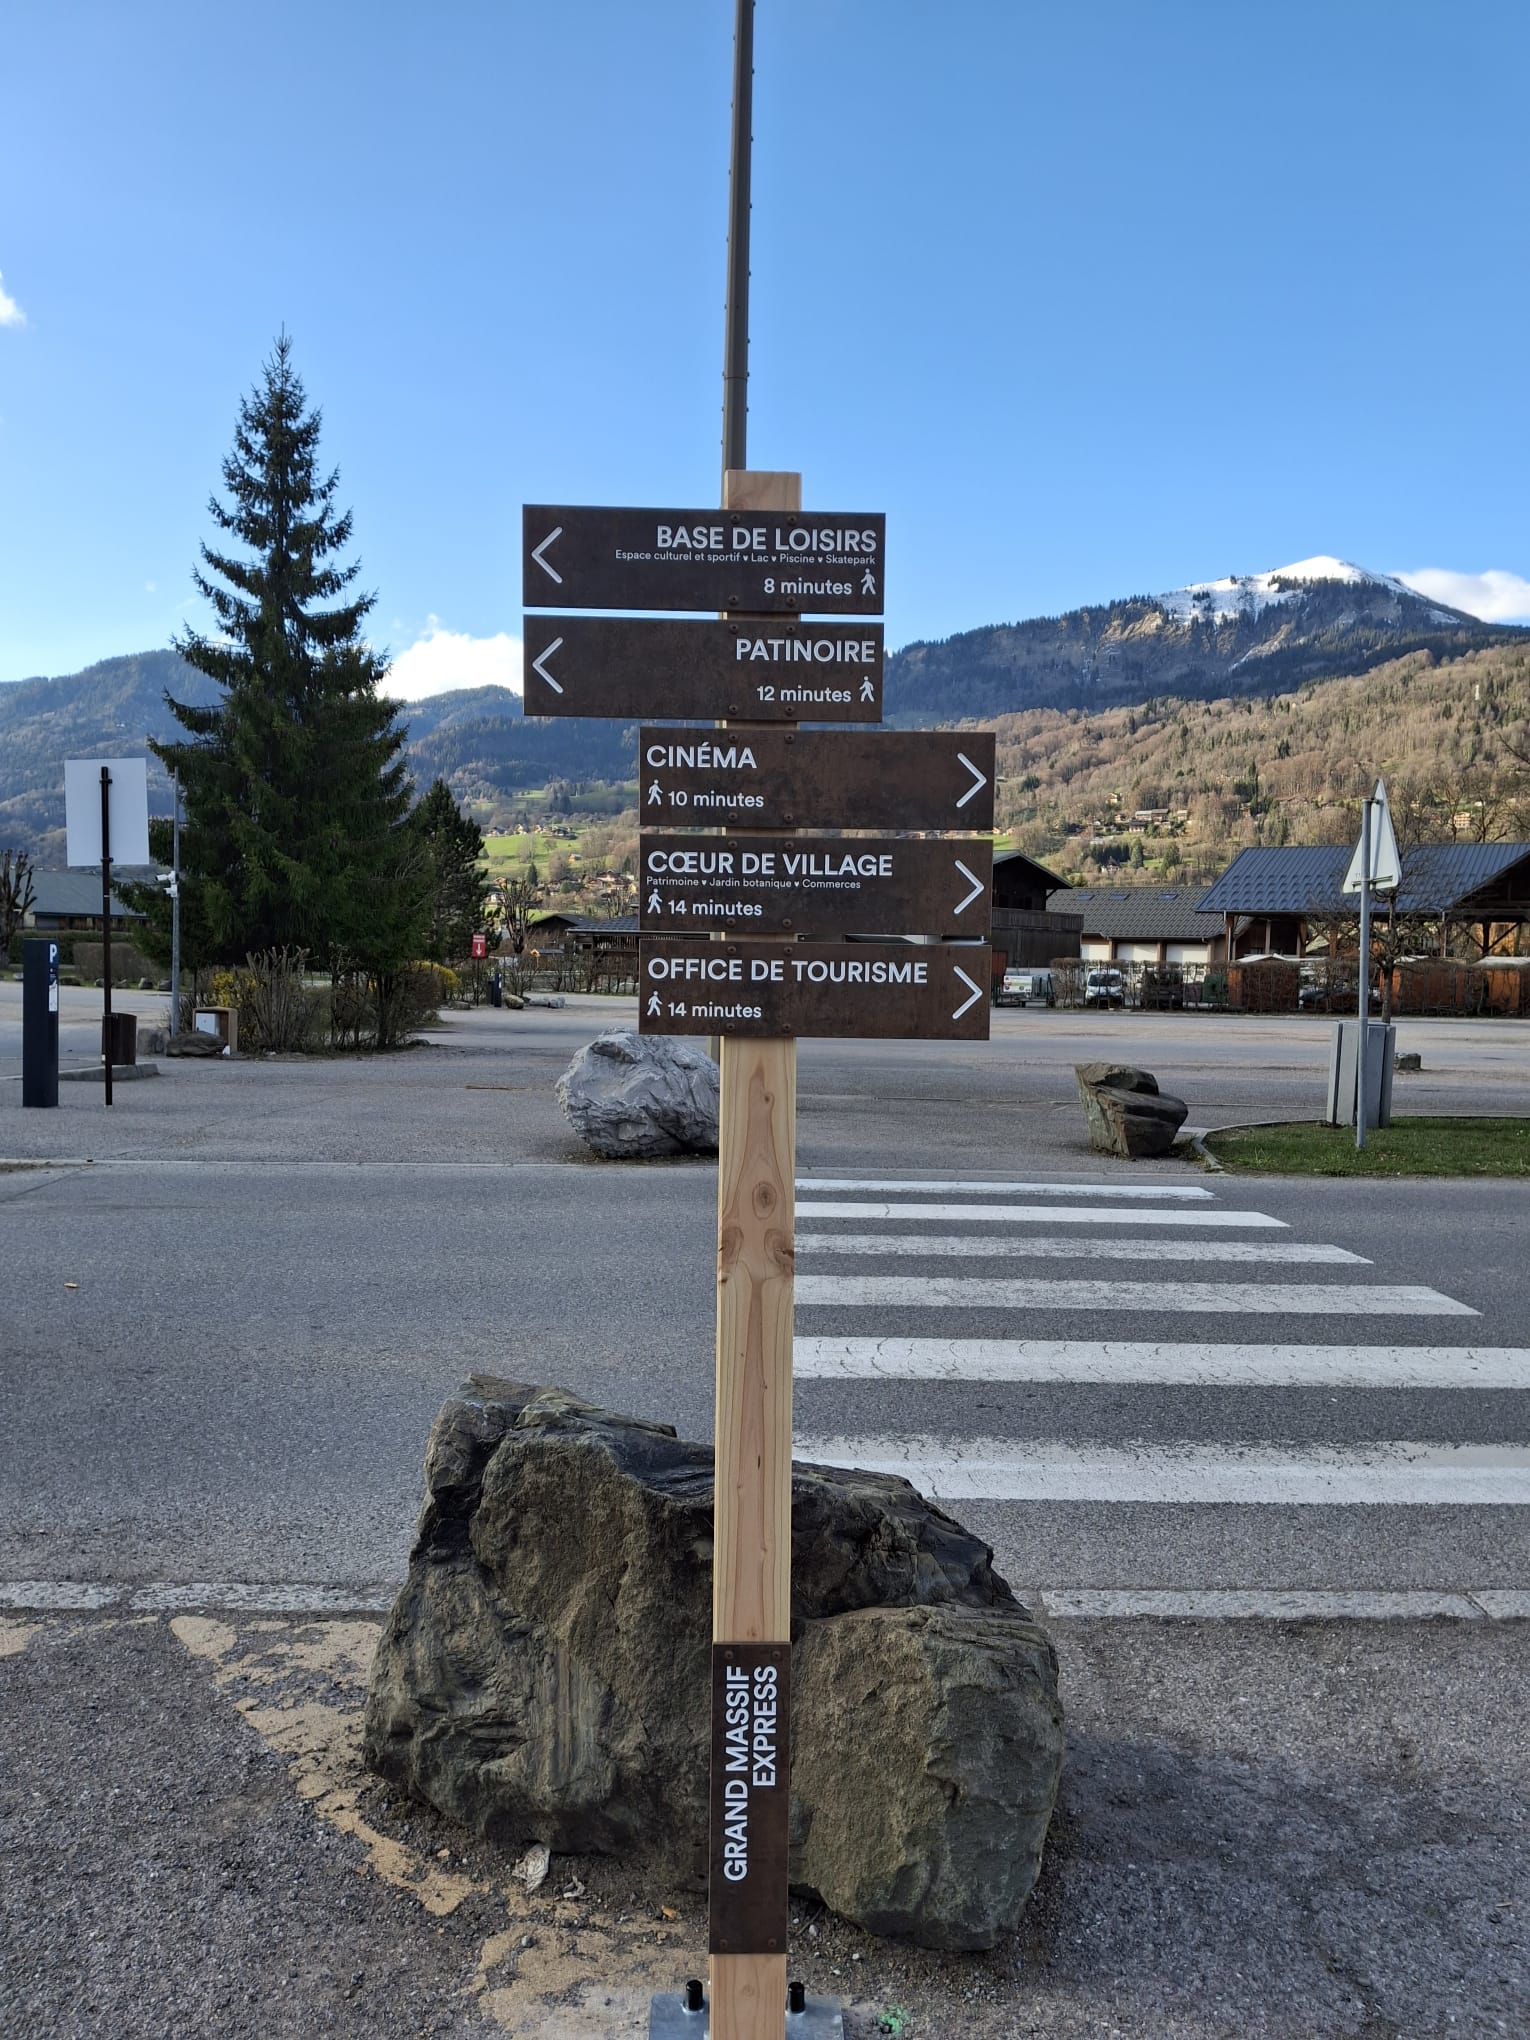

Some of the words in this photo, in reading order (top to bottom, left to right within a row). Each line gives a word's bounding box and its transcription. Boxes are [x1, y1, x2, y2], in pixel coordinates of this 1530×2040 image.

[657, 525, 724, 550] BASE
[732, 527, 767, 550] DE
[775, 528, 877, 553] LOISIRS
[615, 549, 652, 562] Espace
[653, 550, 693, 562] culturel
[694, 551, 705, 562] et
[707, 551, 741, 564] sportif
[751, 552, 769, 563] Lac
[780, 553, 815, 564] Piscine
[825, 553, 876, 566] Skatepark
[763, 578, 775, 594] 8
[780, 578, 852, 595] minutes
[736, 638, 876, 663] PATINOIRE
[756, 685, 775, 701] 12
[780, 685, 852, 703] minutes
[646, 741, 757, 769] CINÉMA
[667, 790, 688, 806] 10
[693, 790, 764, 808] minutes
[647, 850, 734, 875] CŒUR
[741, 852, 776, 875] DE
[783, 853, 893, 877] VILLAGE
[646, 876, 699, 887] Patrimoine
[709, 877, 741, 888] Jardin
[743, 878, 792, 890] botanique
[802, 879, 861, 889] Commerces
[667, 899, 687, 915] 14
[692, 898, 763, 916] minutes
[49, 943, 58, 964] P
[647, 957, 743, 981] OFFICE
[751, 959, 785, 981] DE
[791, 960, 928, 984] TOURISME
[667, 1001, 687, 1017] 14
[691, 1001, 762, 1019] minutes
[725, 1665, 751, 1773] MASSIF
[752, 1665, 778, 1787] EXPRESS
[723, 1779, 750, 1882] GRAND
